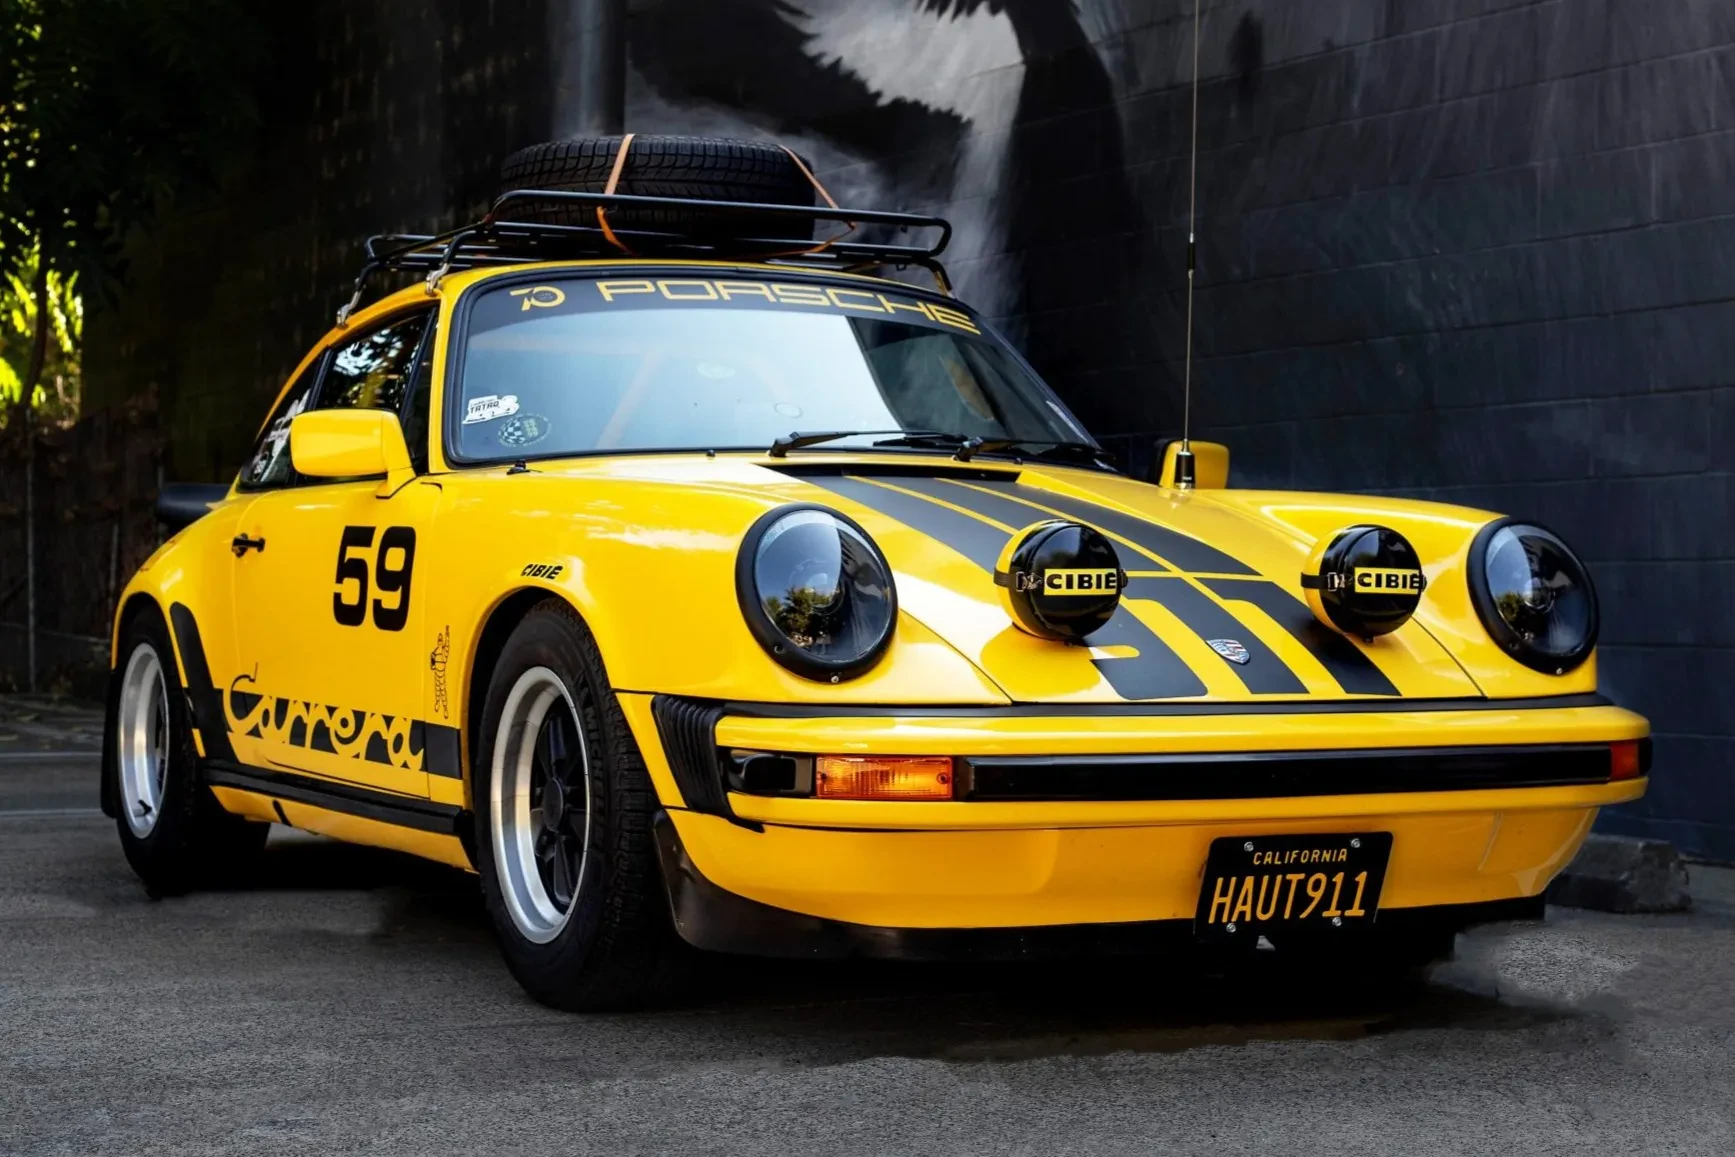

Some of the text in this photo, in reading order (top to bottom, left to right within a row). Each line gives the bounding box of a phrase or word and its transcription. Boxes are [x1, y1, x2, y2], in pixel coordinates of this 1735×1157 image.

[596, 280, 982, 335] PORSCHE
[333, 525, 417, 632] 59
[223, 661, 425, 770] Carrera
[1253, 848, 1348, 865] CALIFORNIA
[1208, 871, 1368, 925] HAUT911
